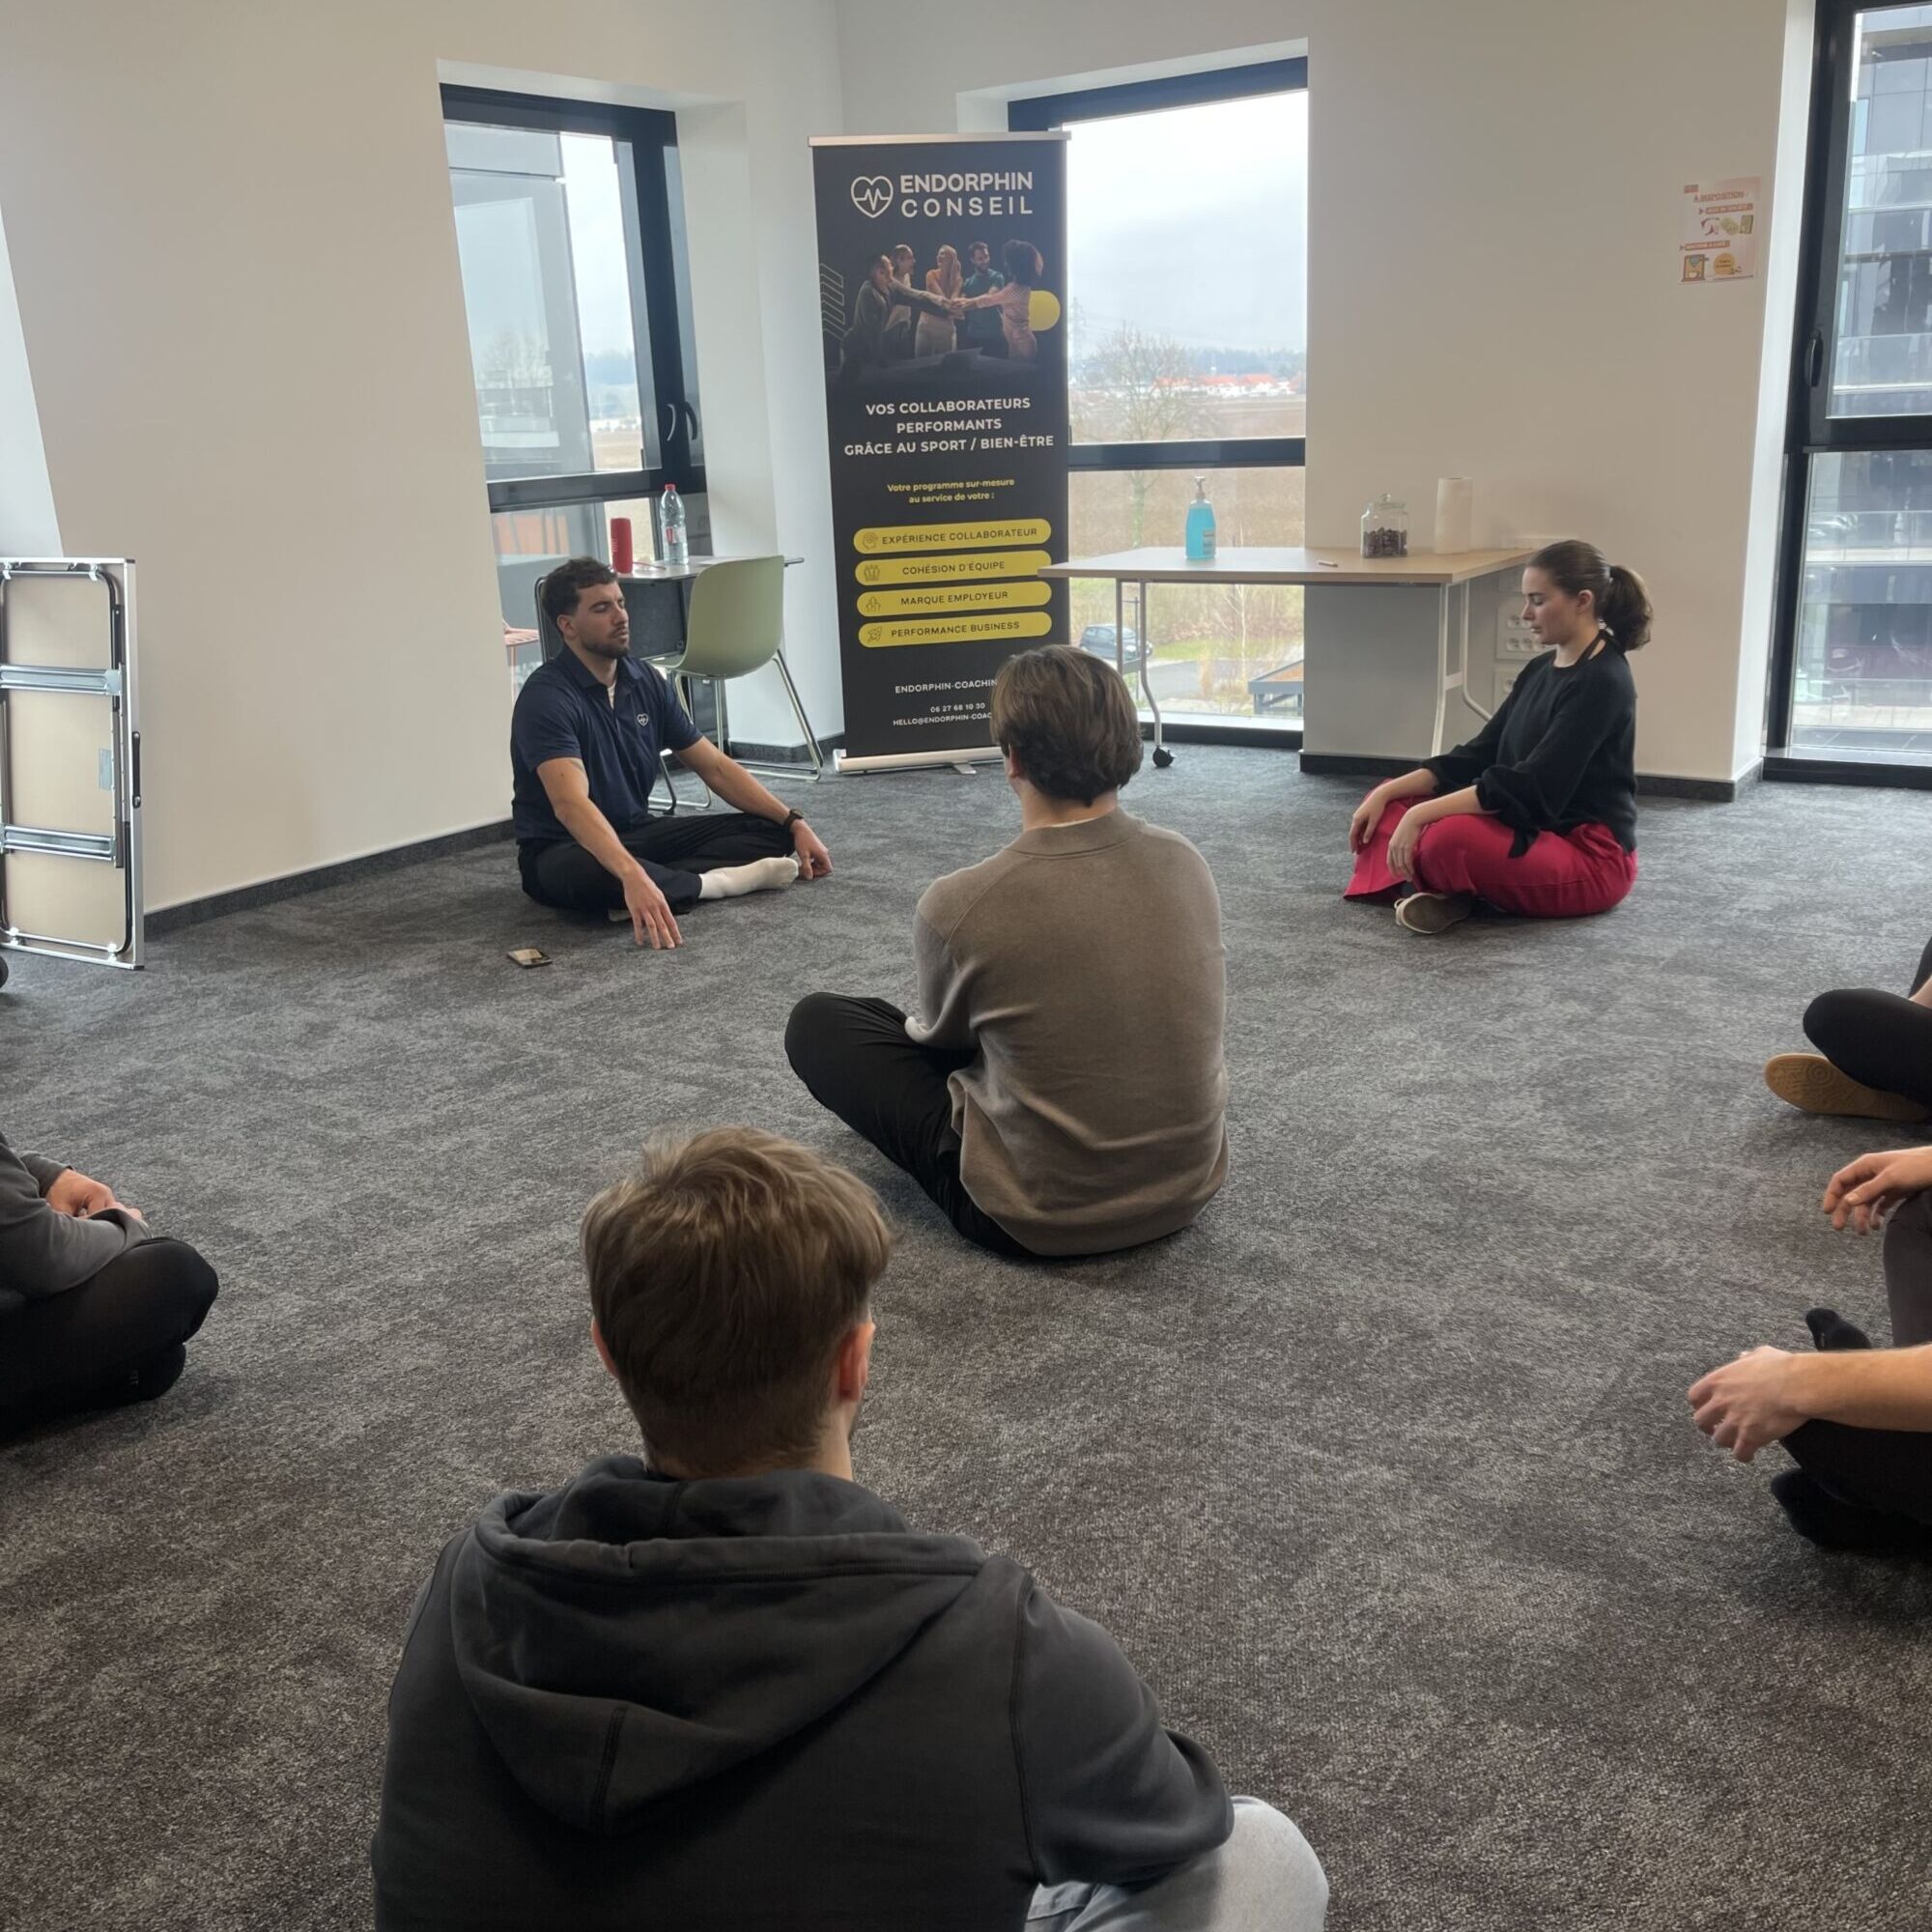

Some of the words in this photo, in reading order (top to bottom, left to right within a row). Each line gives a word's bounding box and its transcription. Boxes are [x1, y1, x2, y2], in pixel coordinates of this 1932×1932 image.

[900, 171, 1033, 193] ENDORPHIN
[900, 196, 1033, 218] CONSEIL
[866, 403, 895, 415] VOS
[899, 397, 1031, 414] COLLABORATEURS
[896, 418, 1002, 434] PERFORMANTS
[844, 440, 893, 456] GRÂCE
[896, 441, 916, 454] AU
[921, 439, 966, 452] SPORT
[970, 438, 976, 451] /
[980, 434, 1054, 450] BIEN-ÊTRE
[888, 483, 911, 493] Votre
[913, 480, 964, 493] programme
[966, 478, 1014, 489] sur-mesure
[922, 494, 952, 503] service
[954, 492, 965, 501] de
[967, 492, 989, 500] votre
[882, 532, 946, 545] EXPÉRIENCE
[949, 527, 1037, 541] COLLABORATEUR
[902, 563, 955, 576] COHÉSION
[959, 560, 1005, 572] D'ÉQUIPE
[900, 594, 945, 606] MARQUE
[948, 591, 1009, 603] EMPLOYEUR
[891, 625, 967, 638] PERFORMANCE
[970, 621, 1020, 632] BUSINESS
